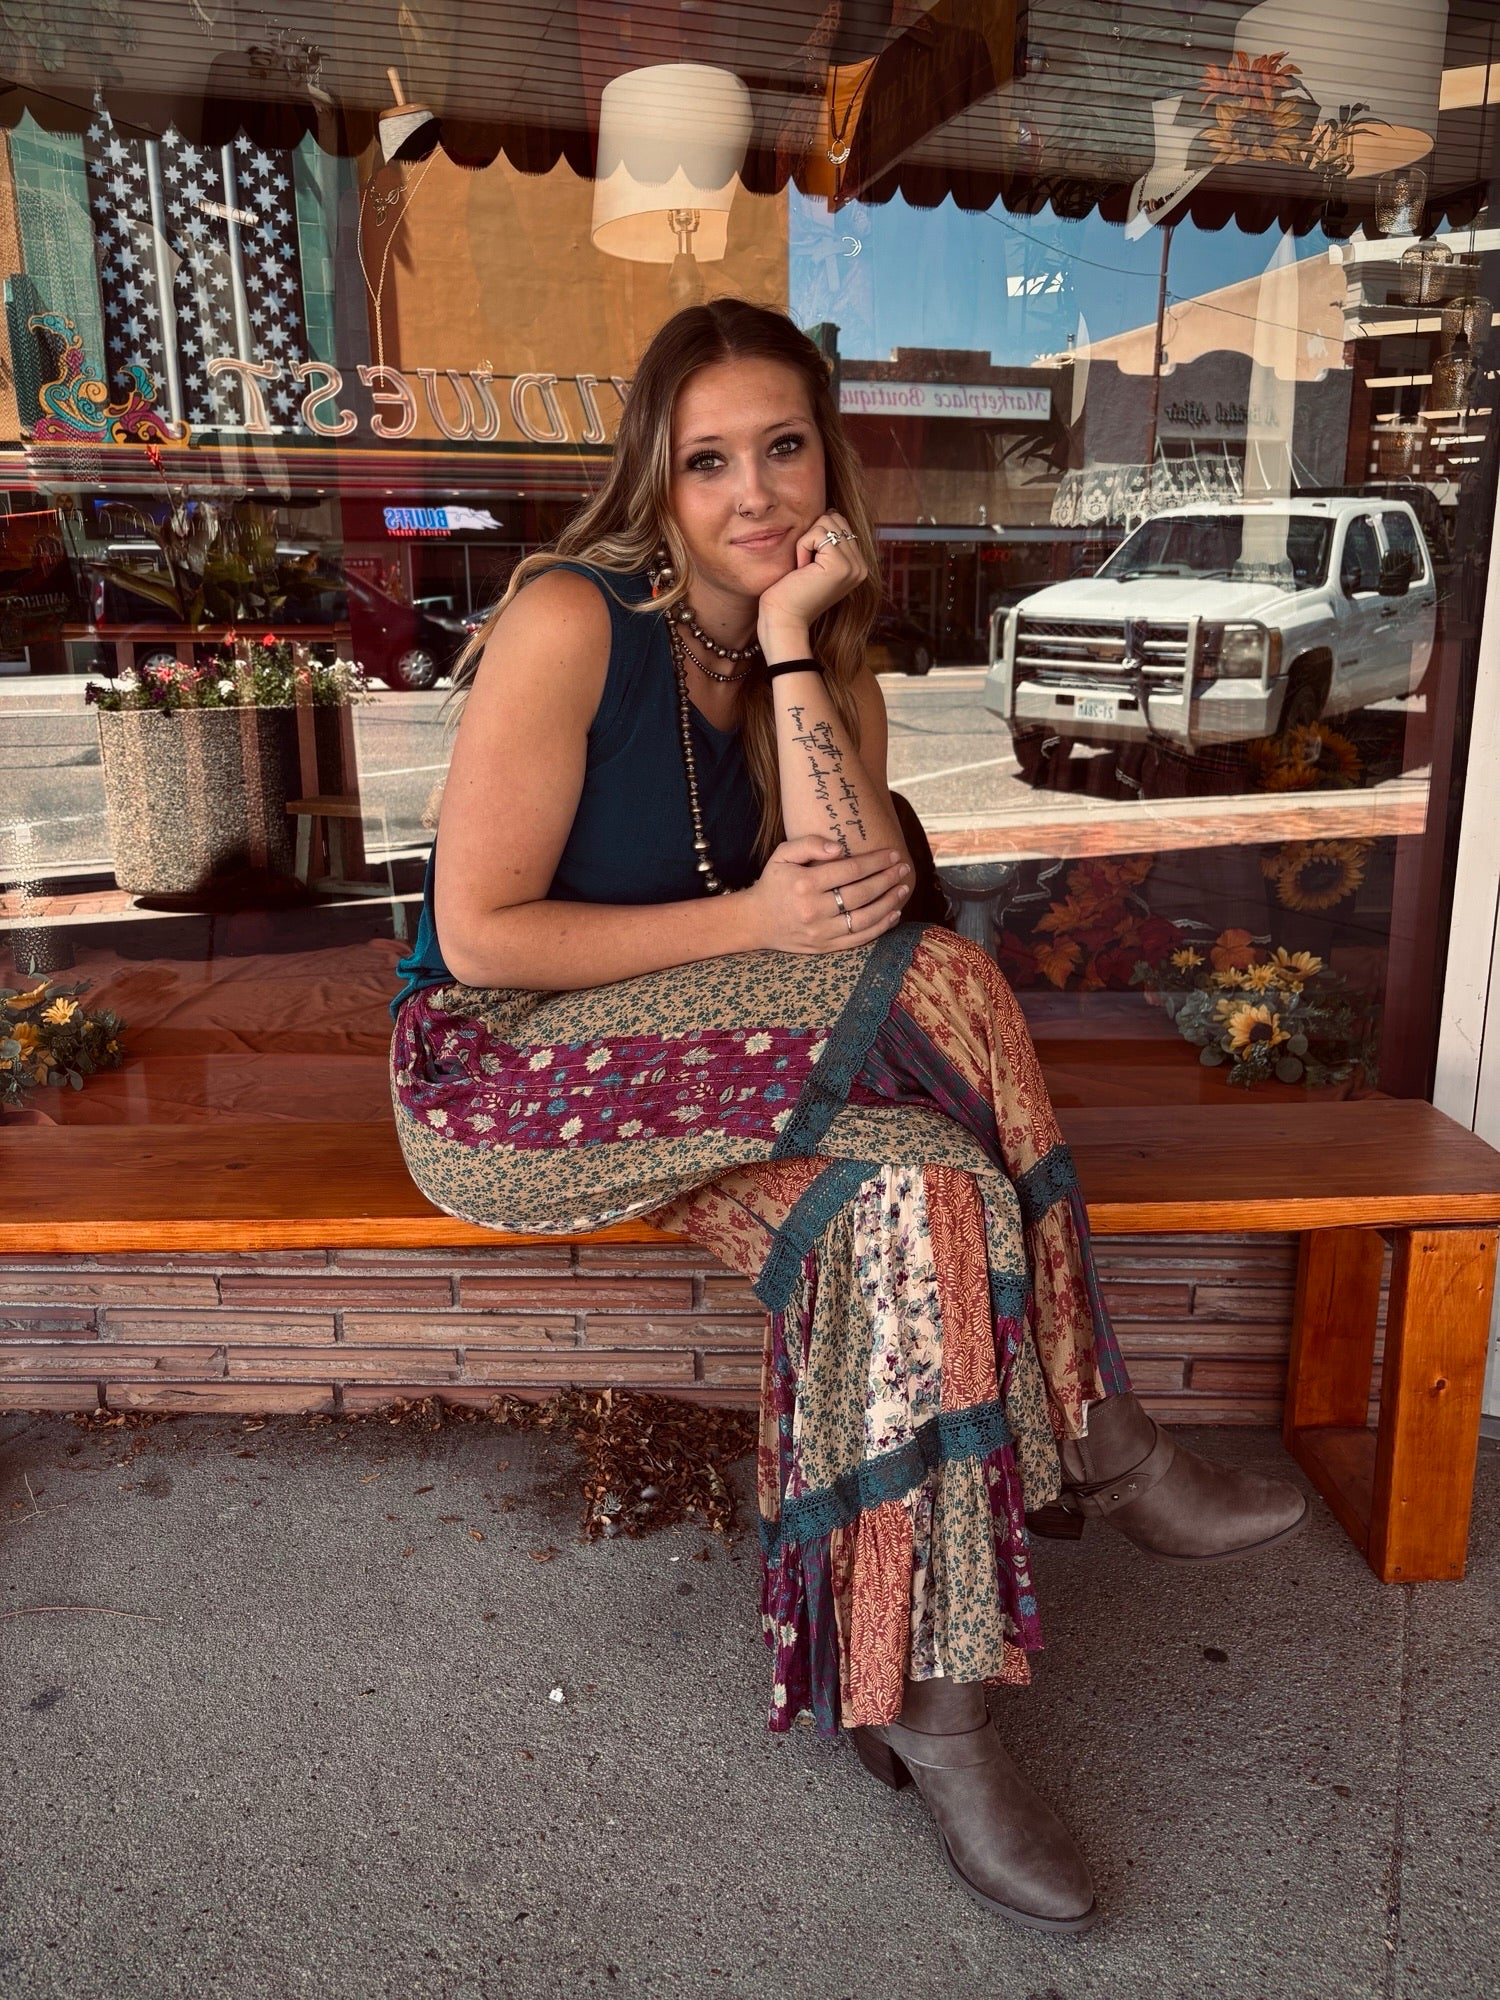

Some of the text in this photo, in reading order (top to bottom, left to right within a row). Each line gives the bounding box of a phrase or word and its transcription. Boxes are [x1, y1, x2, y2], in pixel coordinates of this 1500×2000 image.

[787, 706, 805, 732] from
[808, 756, 830, 800] madness
[825, 804, 838, 819] we
[814, 721, 867, 841] strength is what we gain
